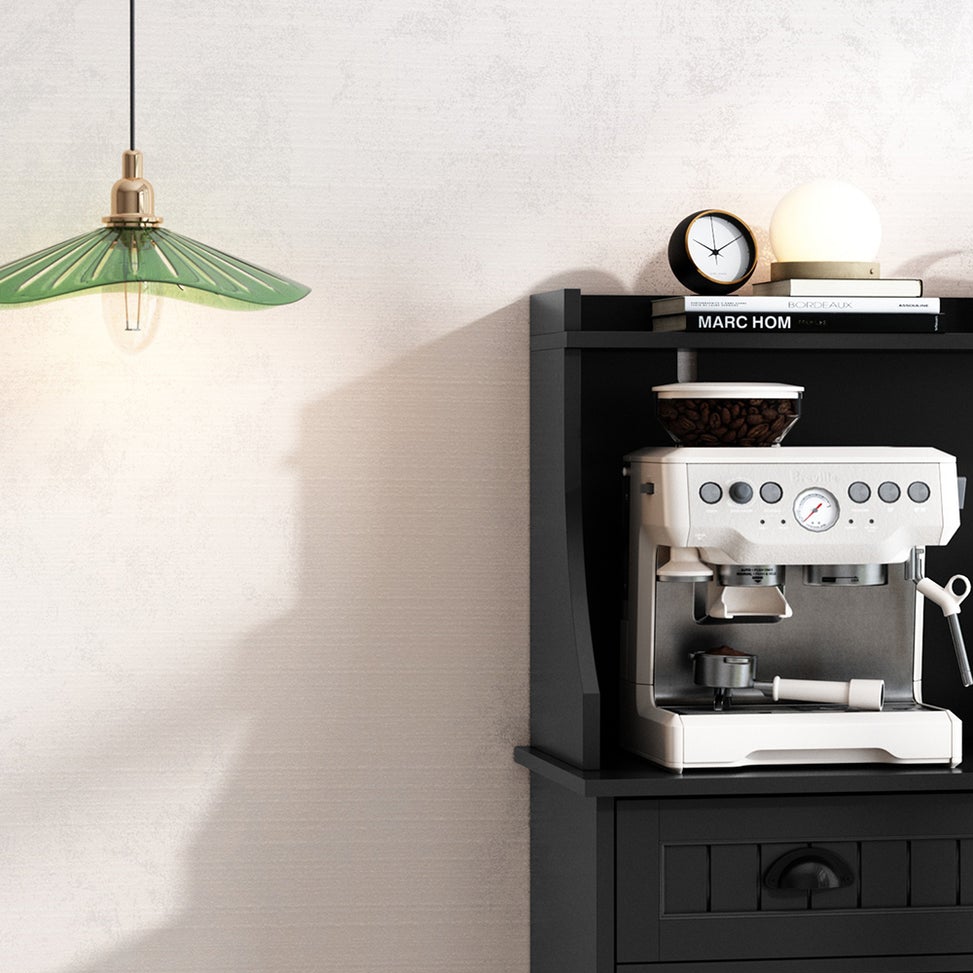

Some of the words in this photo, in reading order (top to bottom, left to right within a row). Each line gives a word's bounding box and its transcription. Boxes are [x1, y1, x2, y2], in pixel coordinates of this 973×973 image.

[787, 301, 853, 309] BORDEAUX
[698, 315, 748, 329] MARC
[752, 315, 792, 329] HOM
